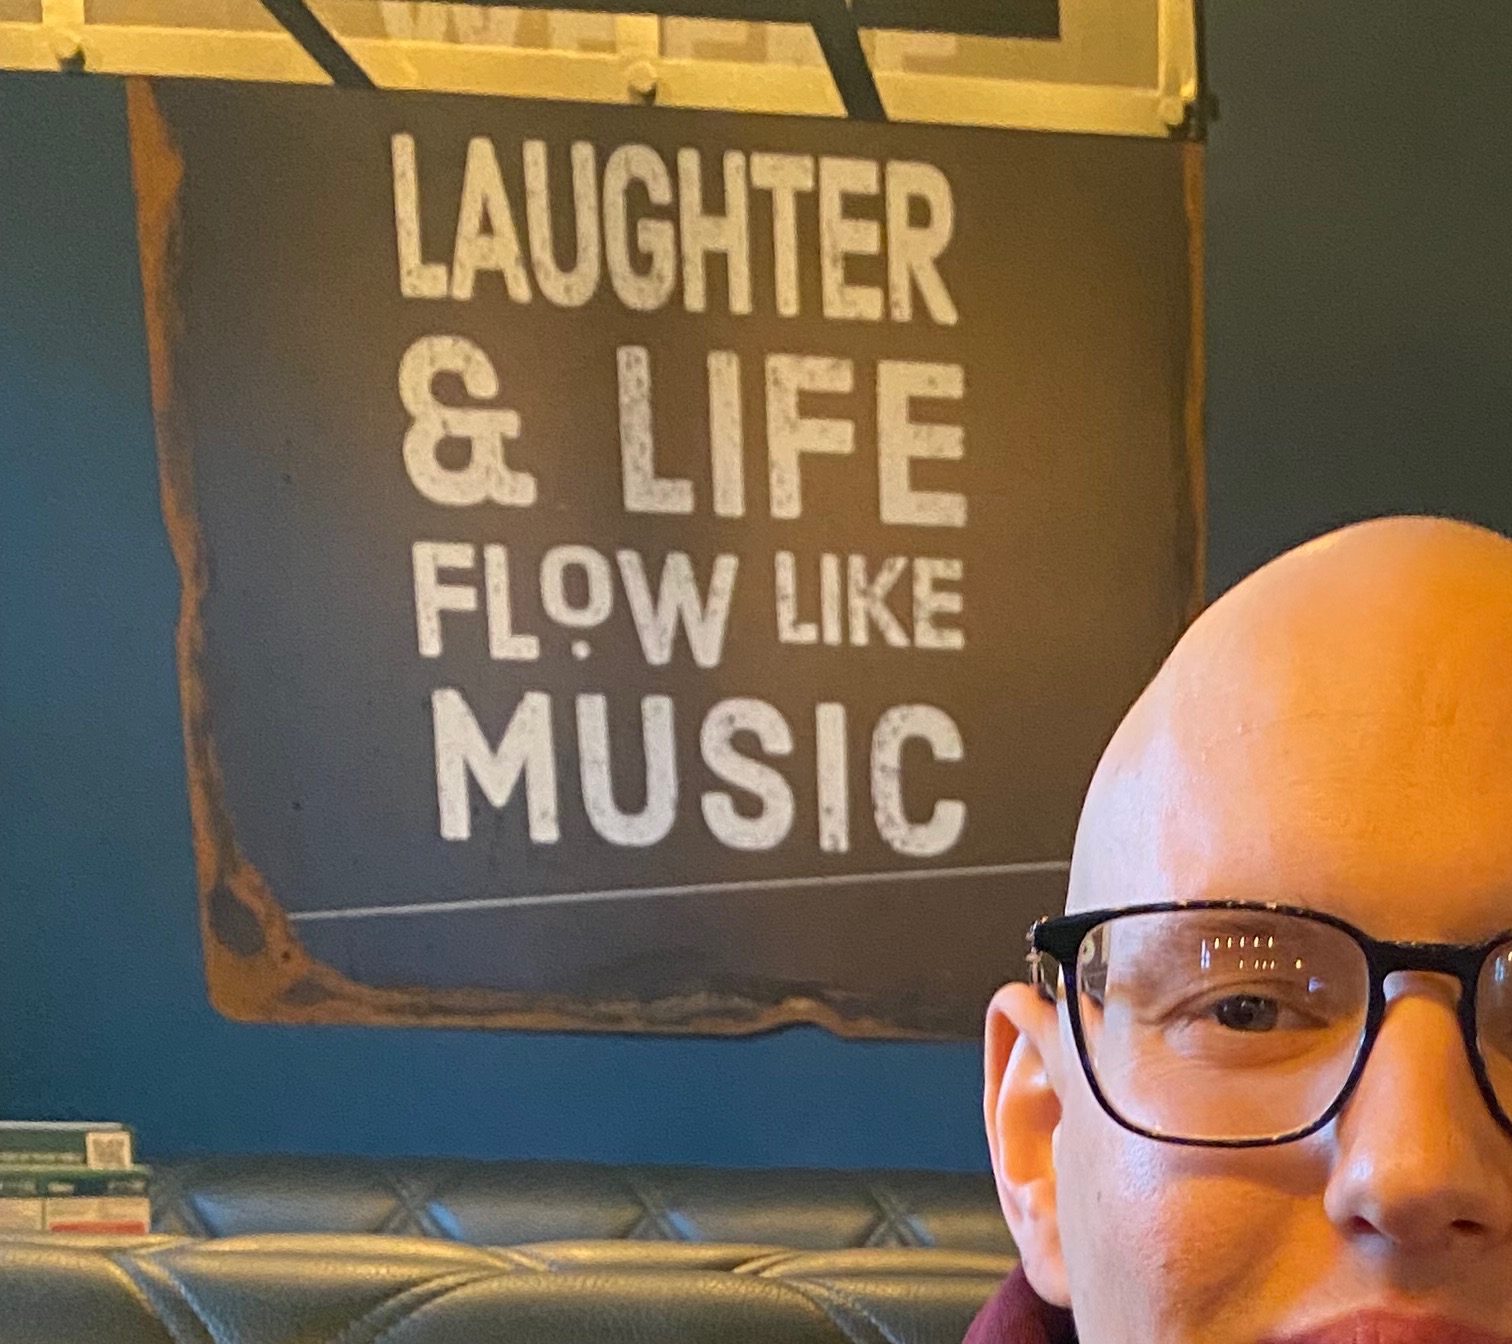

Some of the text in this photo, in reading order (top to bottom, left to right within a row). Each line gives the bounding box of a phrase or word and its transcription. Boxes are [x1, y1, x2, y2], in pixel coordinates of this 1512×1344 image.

[392, 132, 958, 325] LAUGHTER
[396, 335, 967, 528] & LIFE
[411, 540, 965, 667] FLOW LIKE
[432, 689, 965, 856] MUSIC
